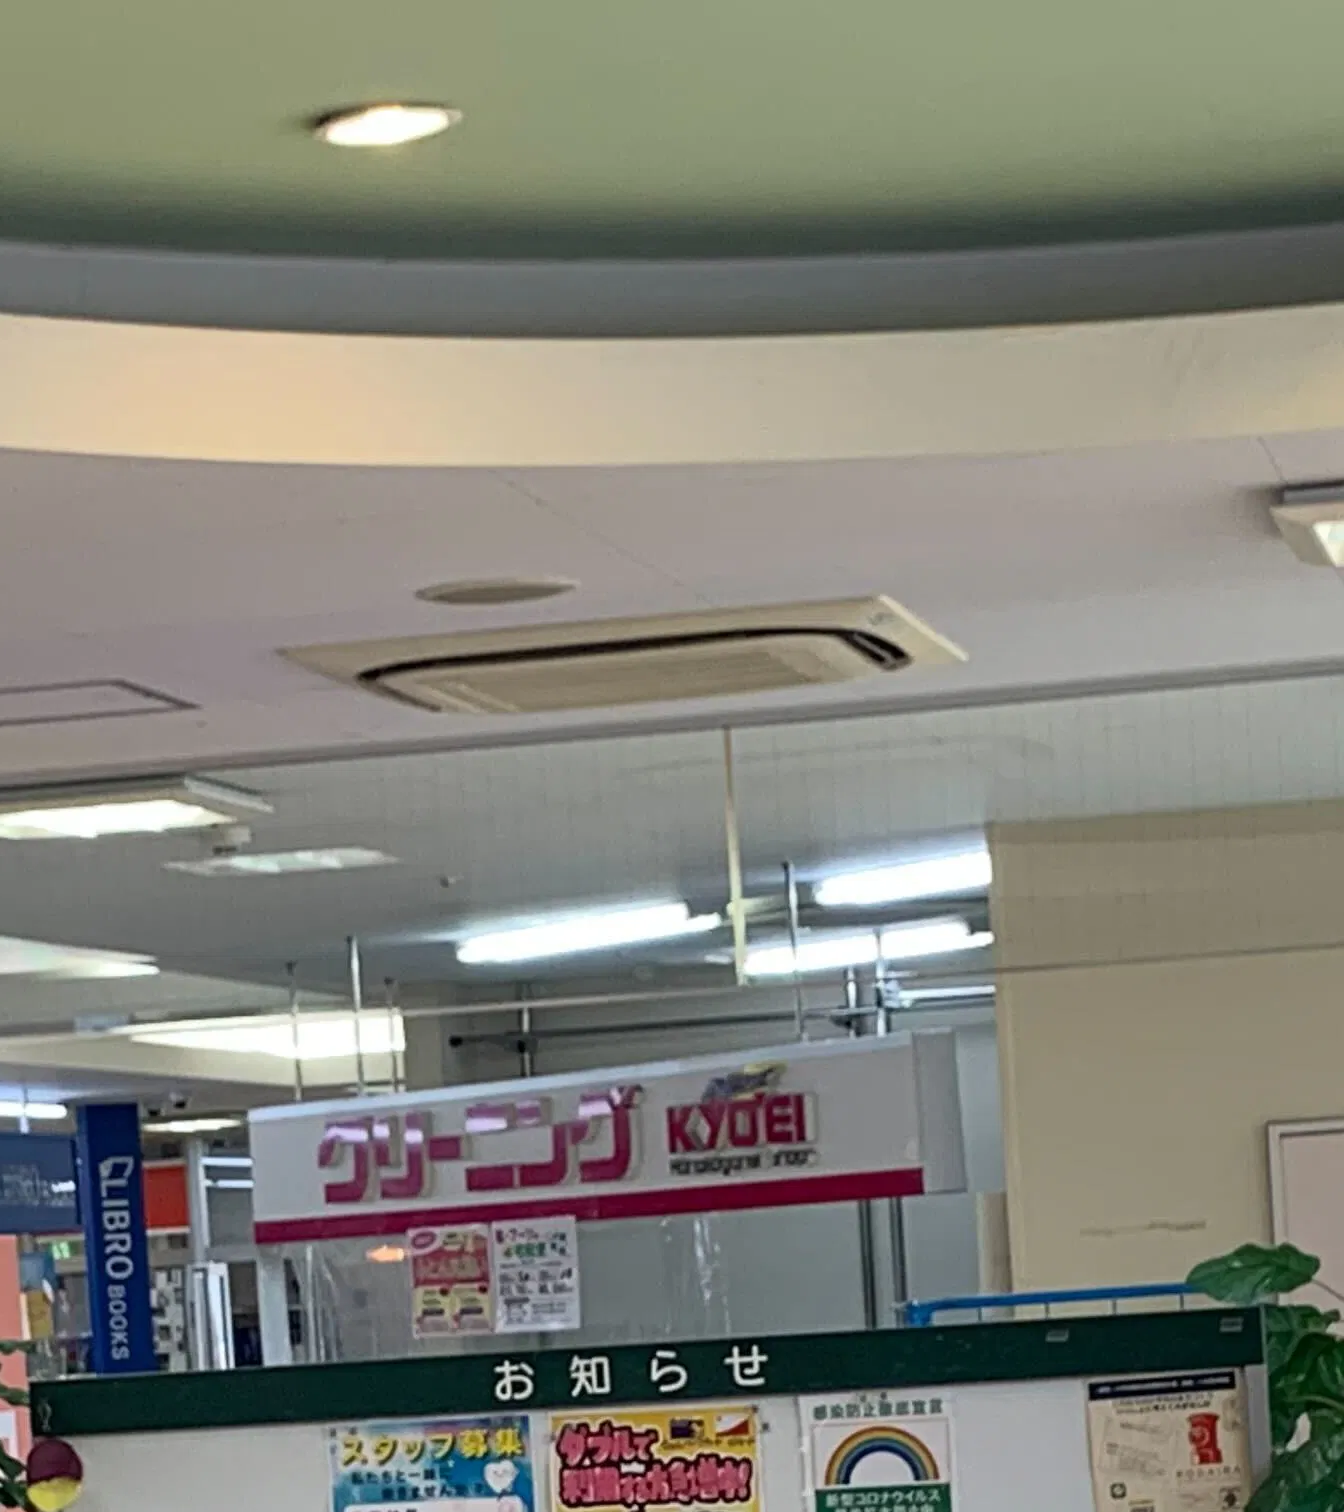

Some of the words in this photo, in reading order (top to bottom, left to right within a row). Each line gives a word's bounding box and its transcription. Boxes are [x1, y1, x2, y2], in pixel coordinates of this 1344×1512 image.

[319, 1085, 643, 1204] クリーニング
[667, 1090, 808, 1154] KYOEI
[107, 1284, 131, 1361] BOOKS
[493, 1345, 769, 1400] お知らせ
[342, 1427, 525, 1466] スタッフ募集
